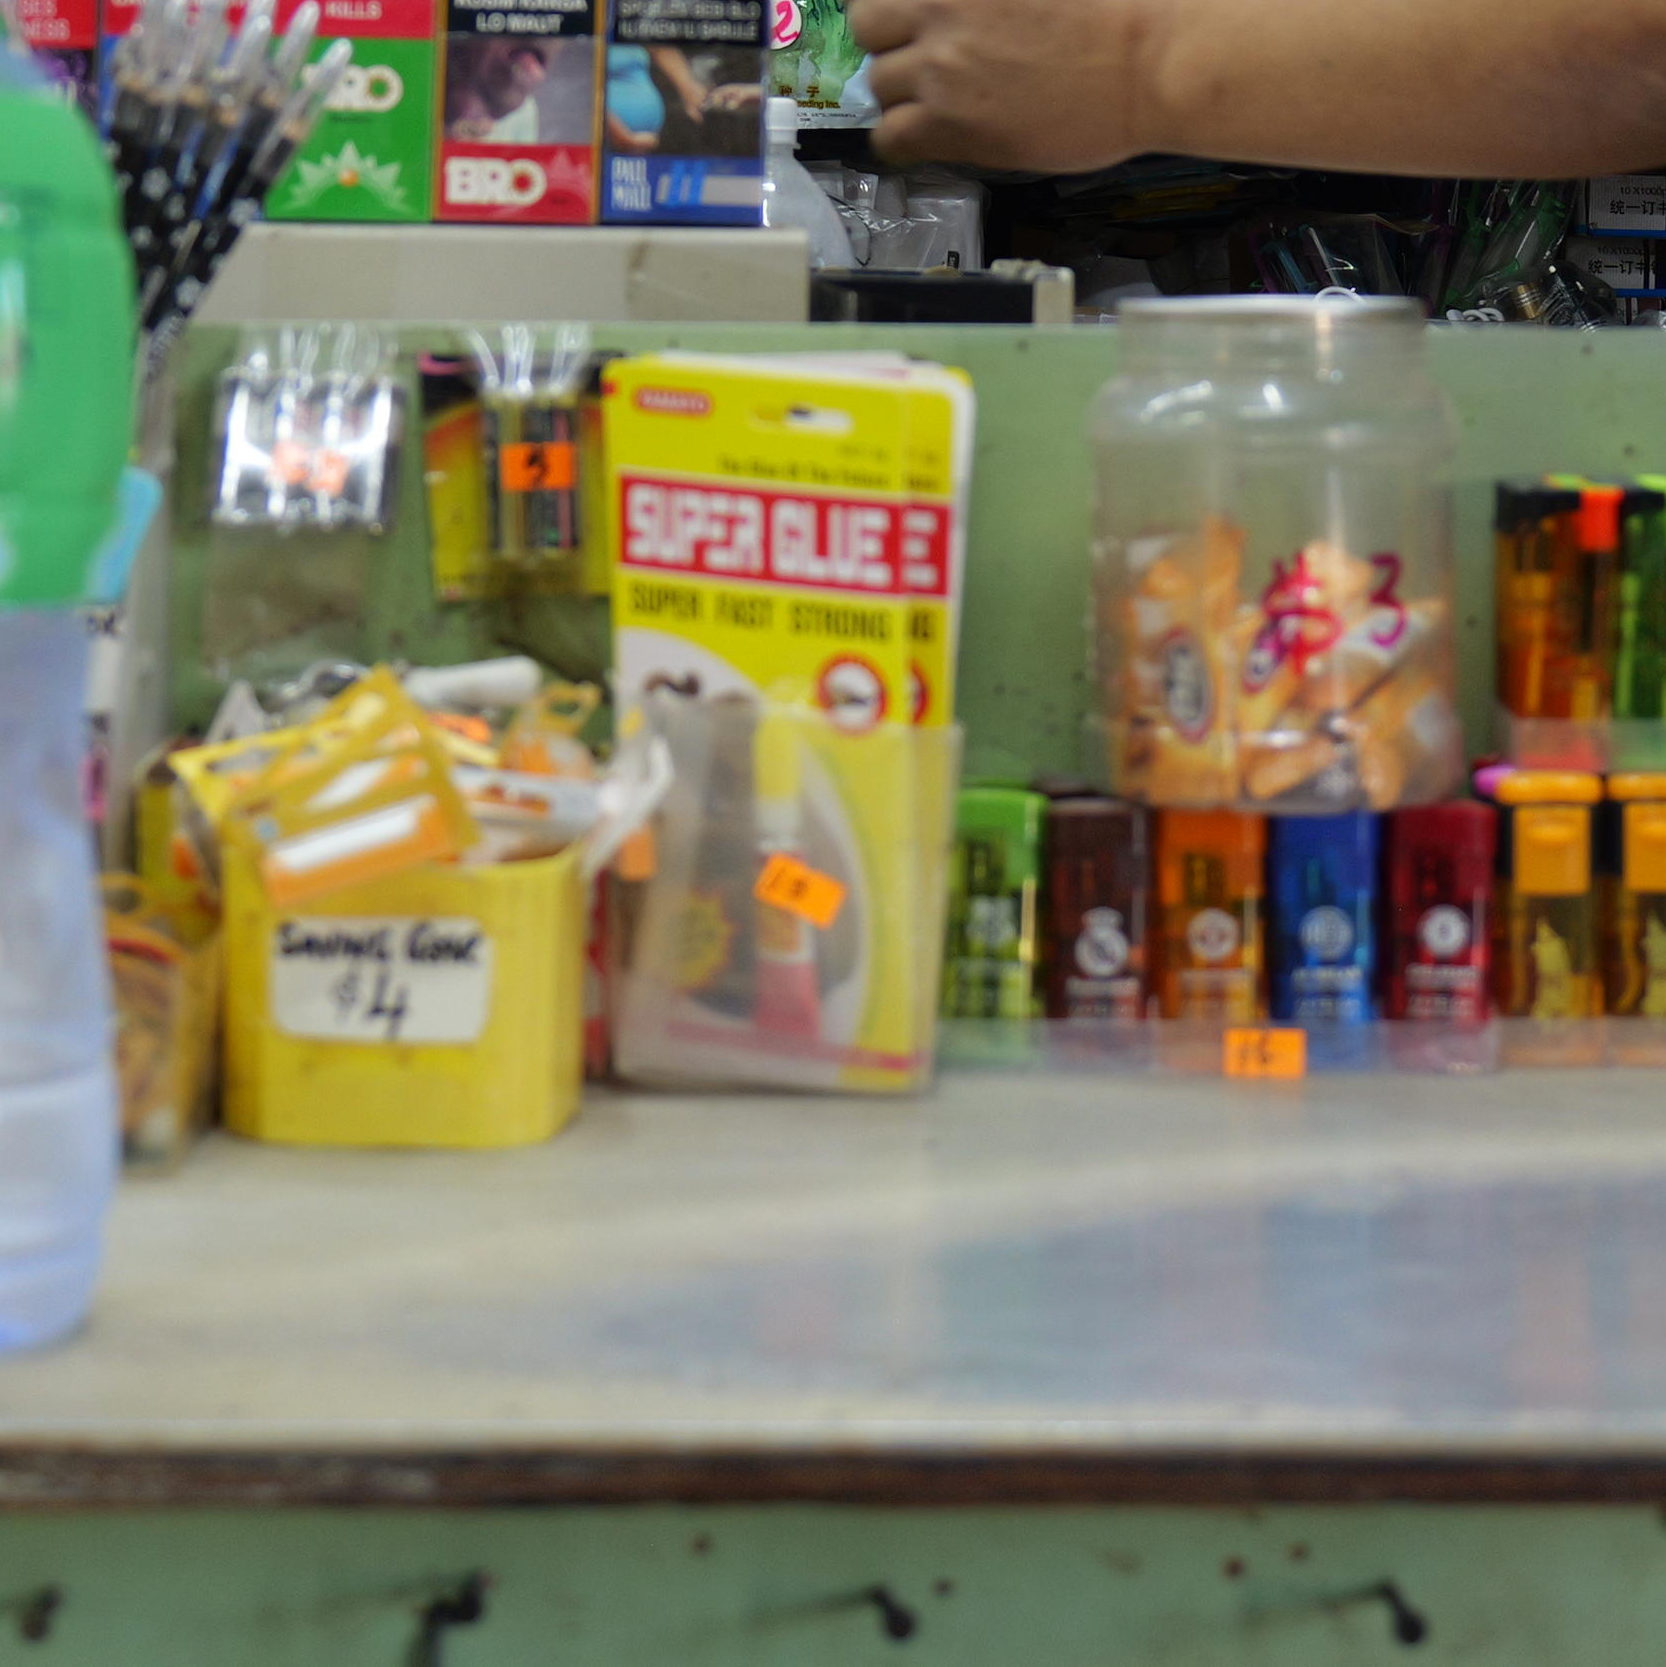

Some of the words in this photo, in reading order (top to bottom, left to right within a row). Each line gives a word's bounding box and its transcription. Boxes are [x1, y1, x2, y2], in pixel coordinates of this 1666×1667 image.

[476, 14, 501, 33] LO
[443, 156, 547, 207] BRO
[627, 482, 767, 578] SUPER
[773, 499, 894, 588] GLUE
[629, 585, 700, 625] SUPER
[715, 592, 773, 631] FAST
[789, 602, 893, 642] STRONG
